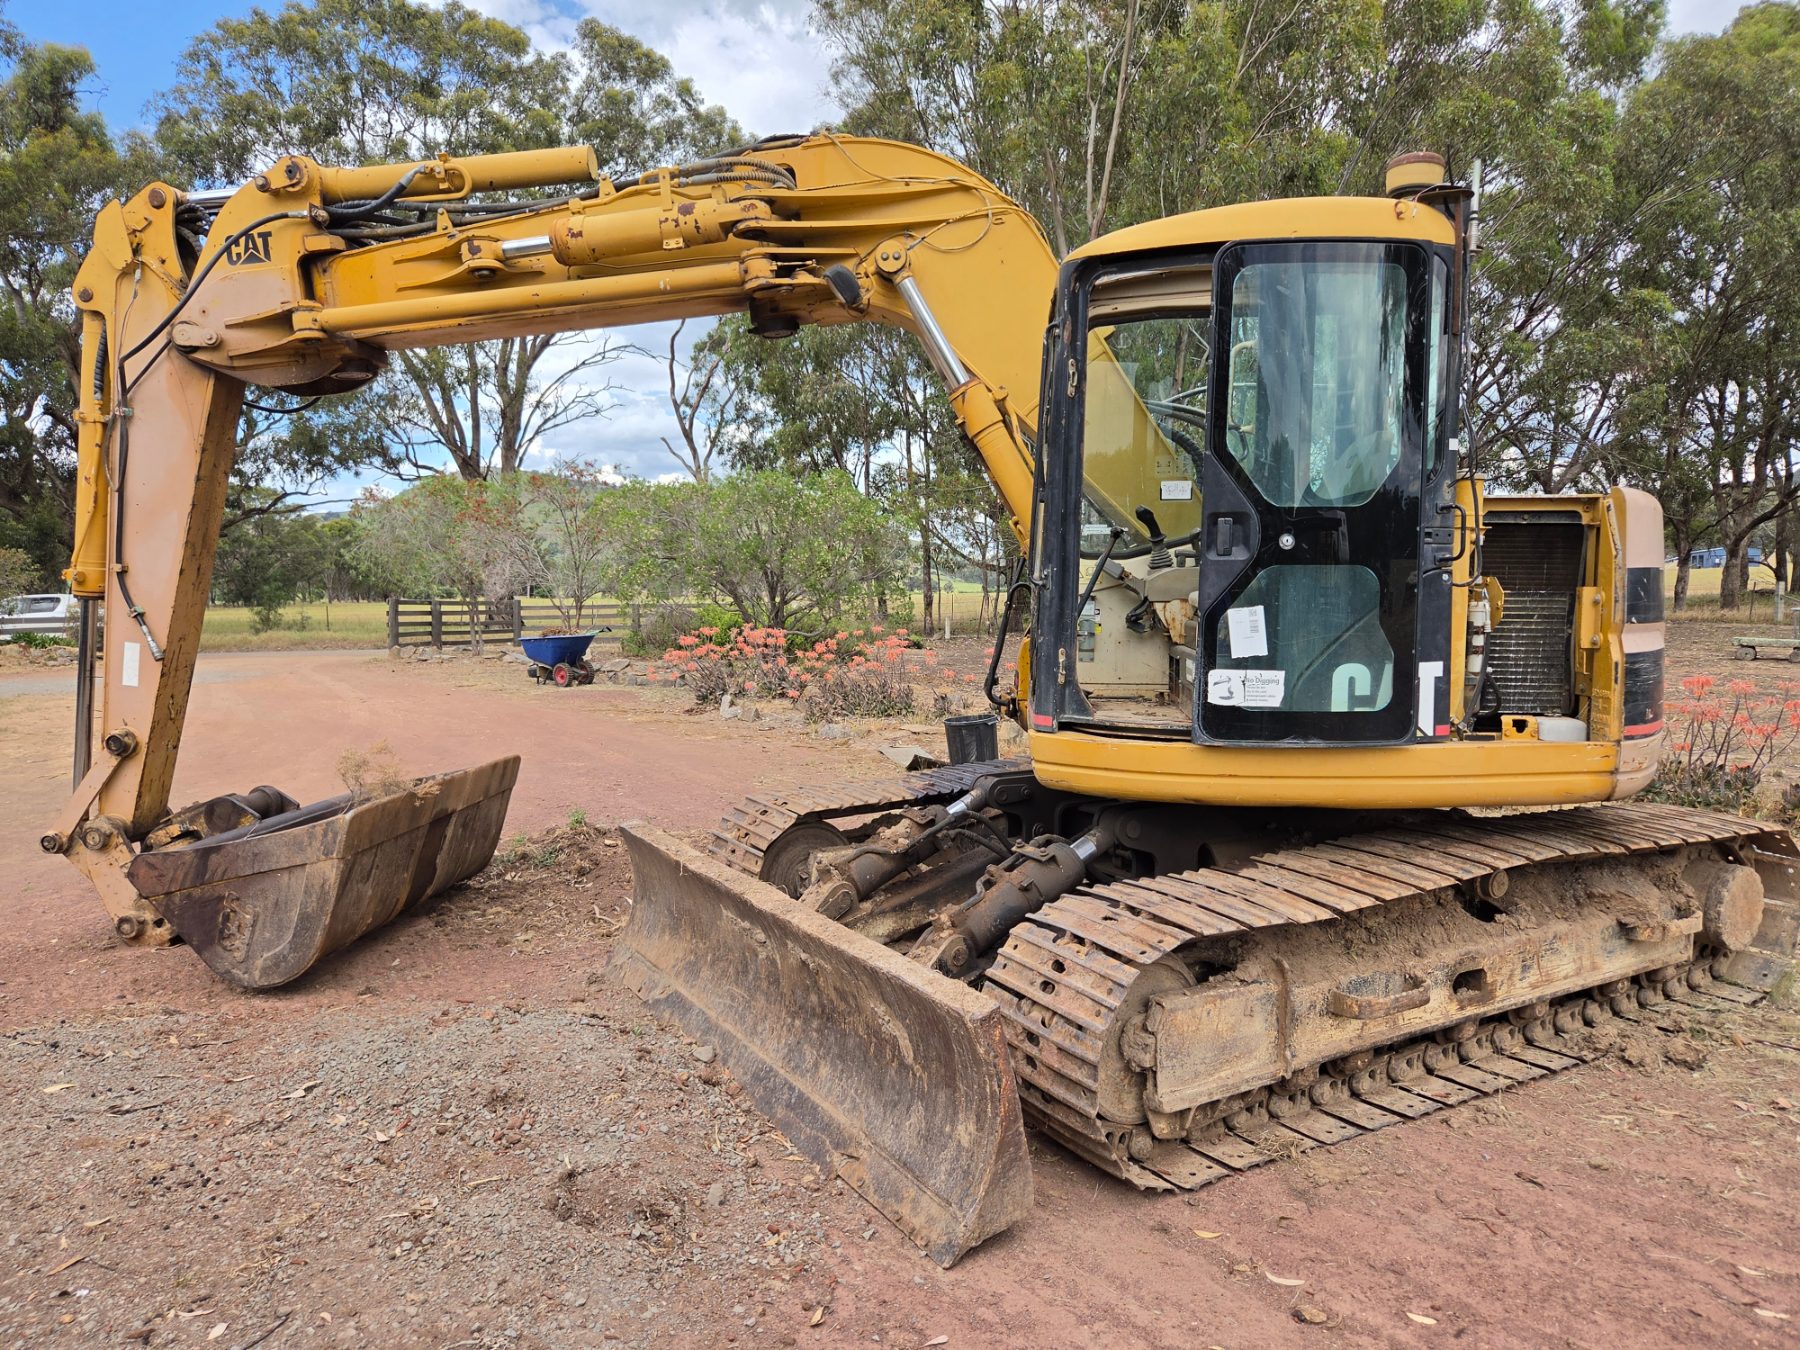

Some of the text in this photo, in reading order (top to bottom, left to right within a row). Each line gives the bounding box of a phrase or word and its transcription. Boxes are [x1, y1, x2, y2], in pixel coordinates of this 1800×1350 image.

[225, 231, 272, 266] CAT
[1255, 677, 1280, 686] Digging
[1331, 661, 1444, 736] CT
